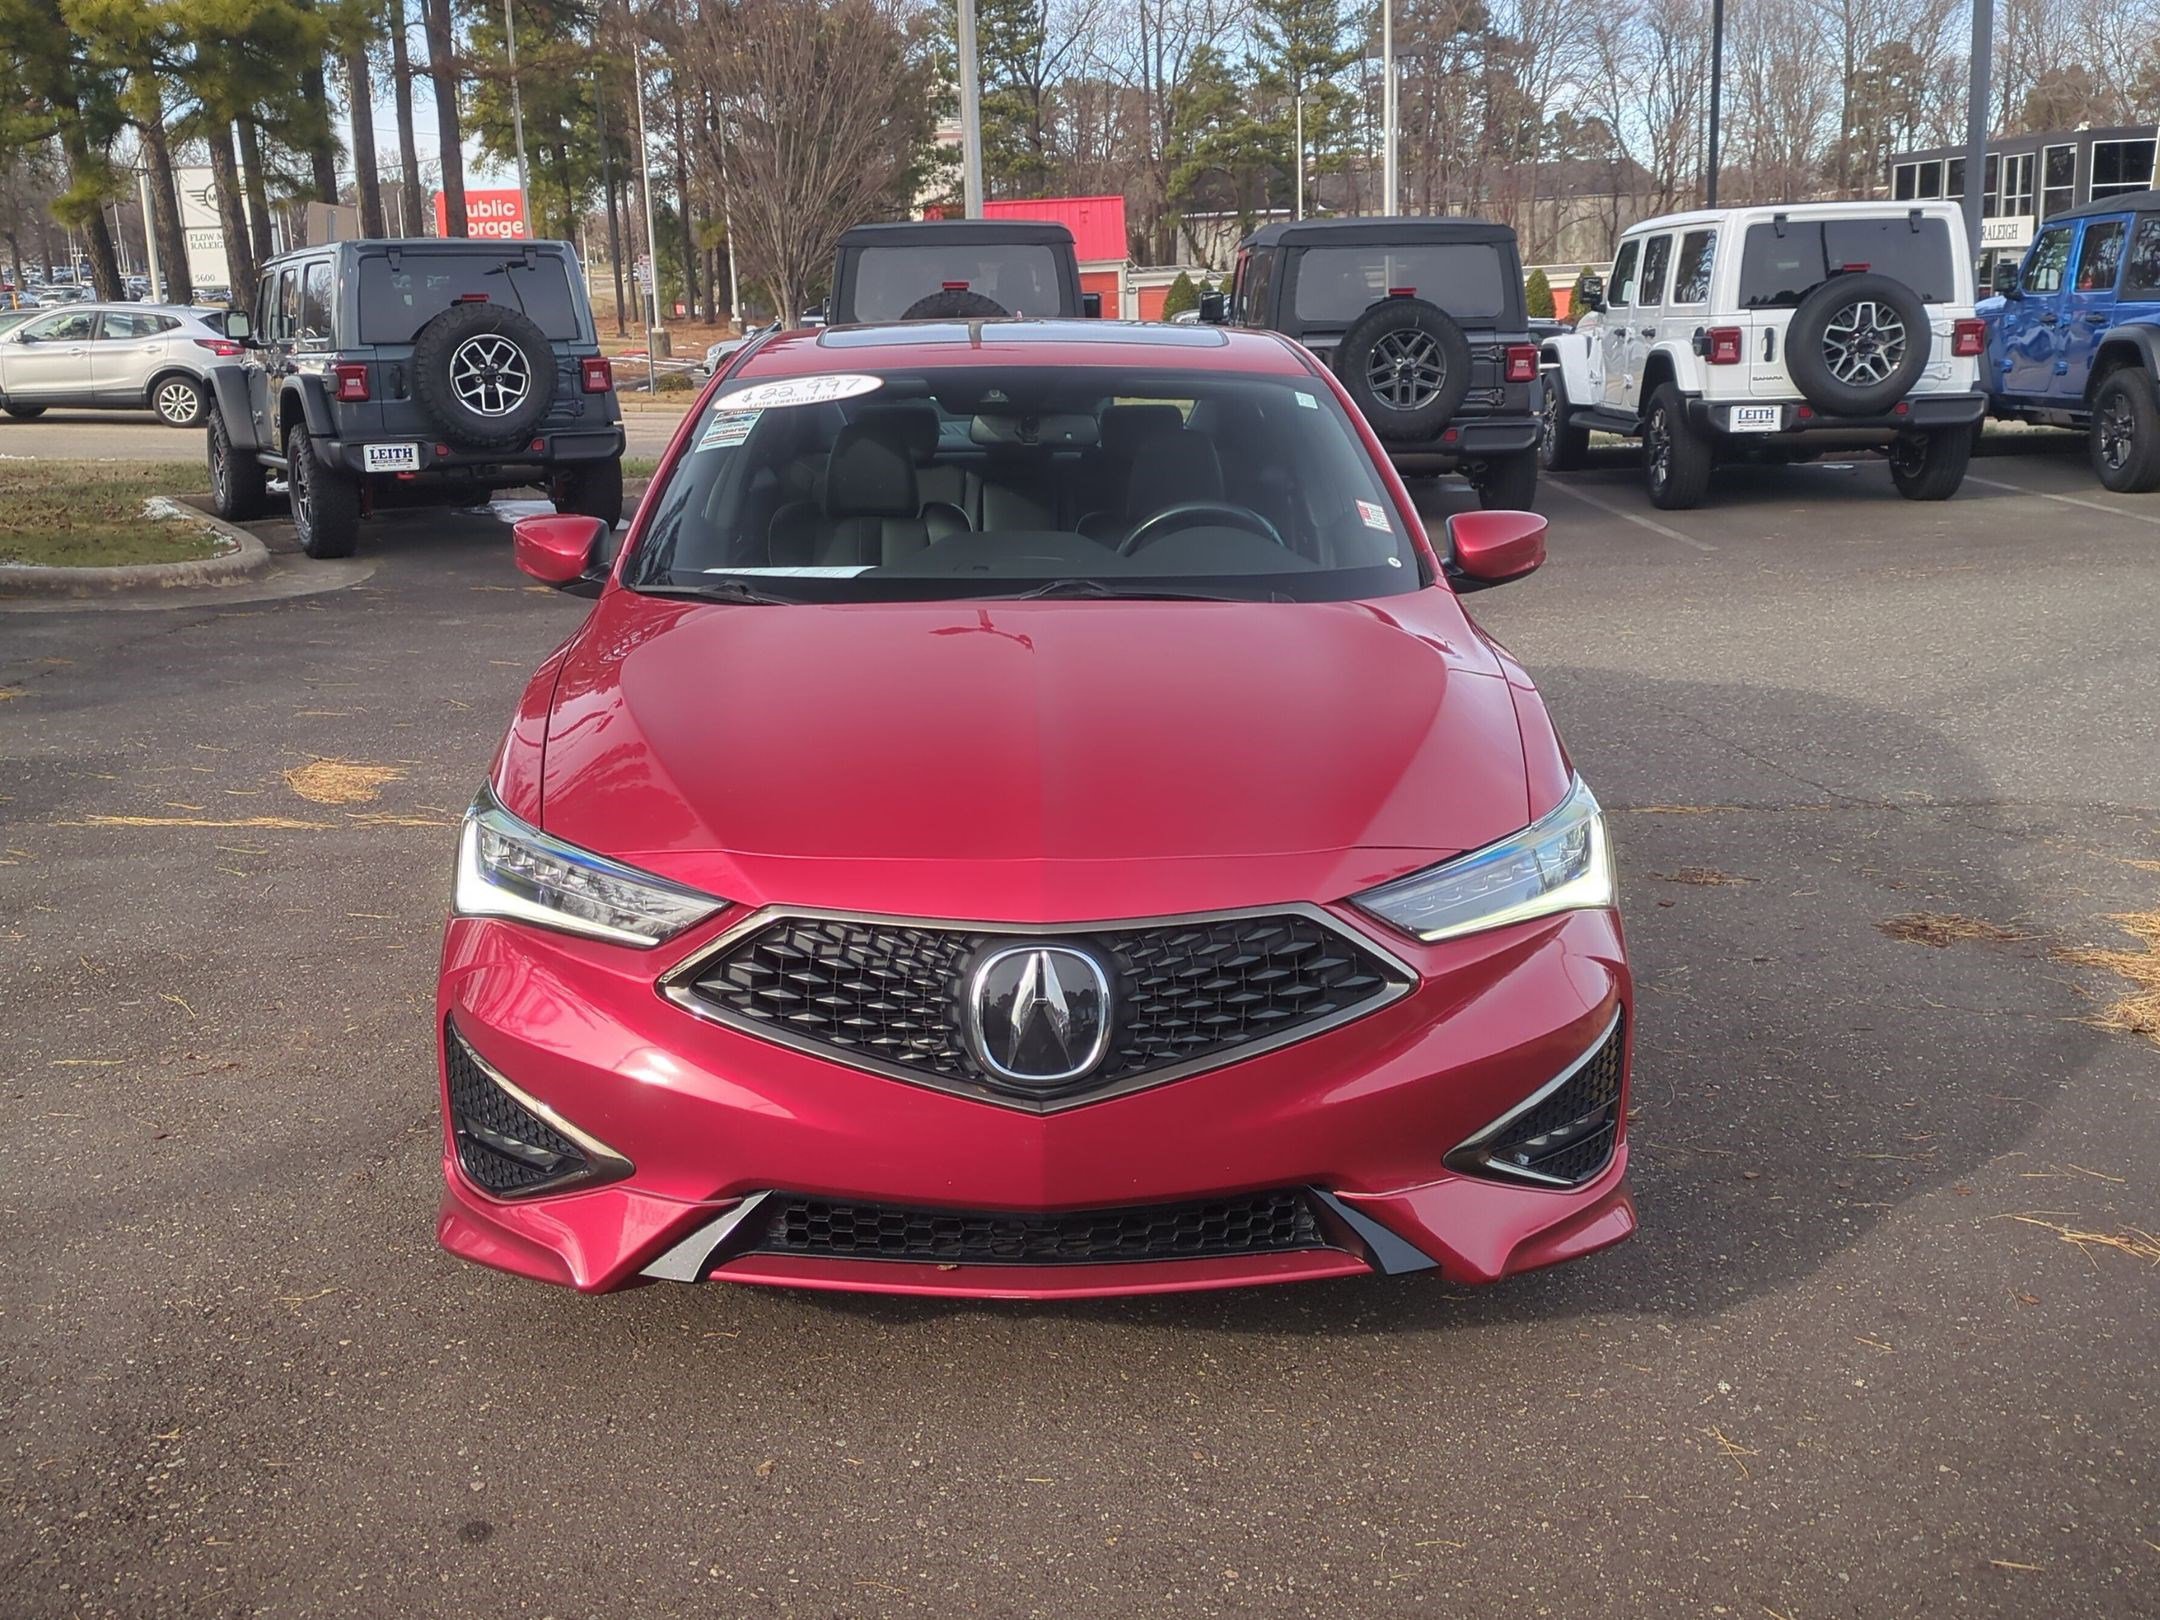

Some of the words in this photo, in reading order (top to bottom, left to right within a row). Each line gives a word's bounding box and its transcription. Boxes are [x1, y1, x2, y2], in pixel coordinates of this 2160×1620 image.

[466, 200, 516, 218] ublic
[468, 221, 524, 239] orage
[190, 233, 215, 241] FLOW
[191, 241, 223, 250] RALEIG
[195, 274, 216, 282] 5600
[1738, 409, 1775, 420] LEITH
[369, 447, 413, 460] LEITH
